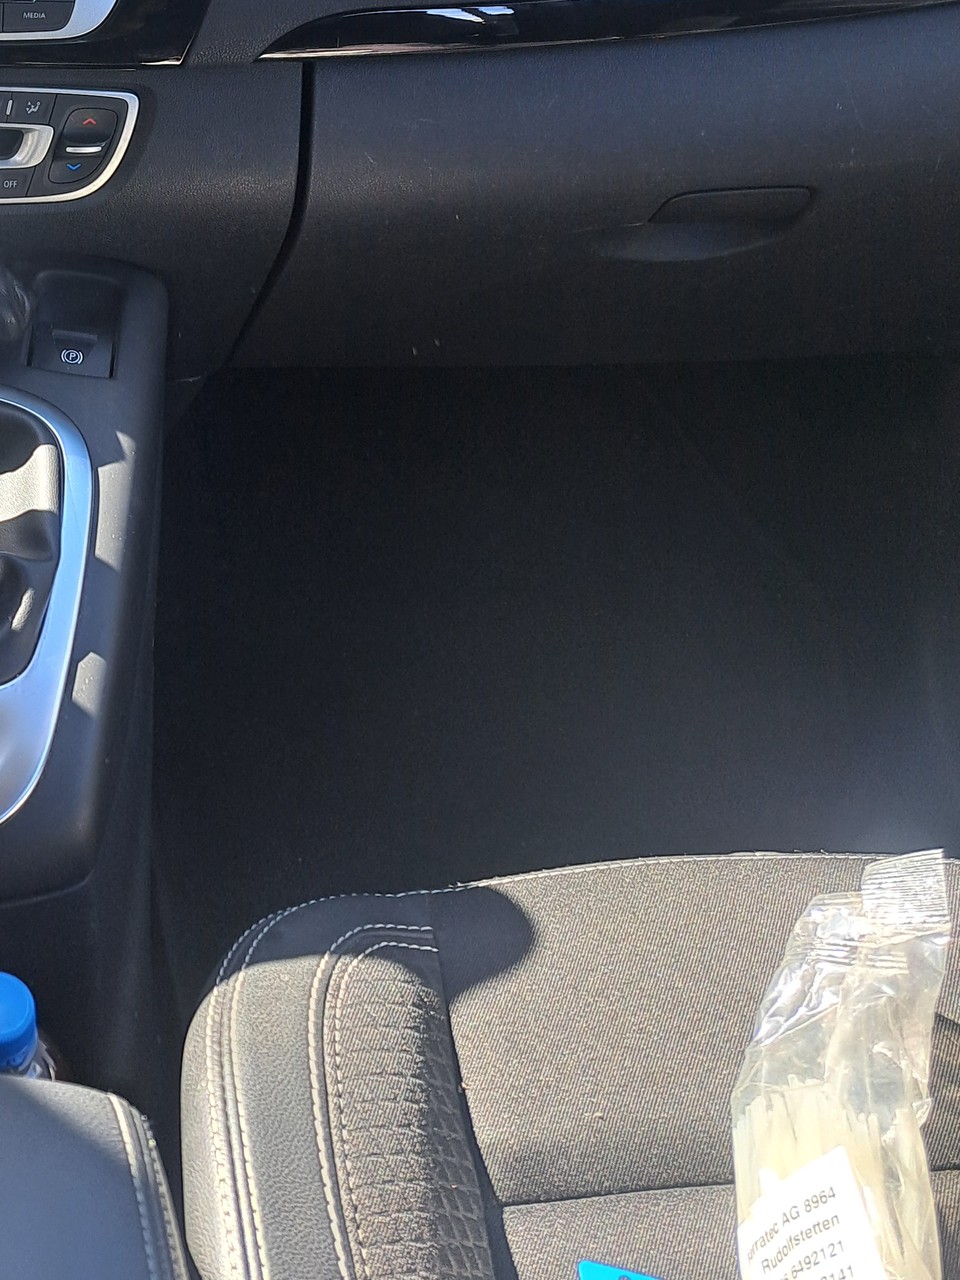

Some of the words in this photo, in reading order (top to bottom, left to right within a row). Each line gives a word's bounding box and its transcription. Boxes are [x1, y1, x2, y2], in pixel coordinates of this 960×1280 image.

[23, 11, 46, 19] MEDIA
[3, 180, 18, 188] OFF
[782, 1205, 801, 1227] AG
[803, 1186, 836, 1213] 8964
[791, 1240, 845, 1280] 6492121
